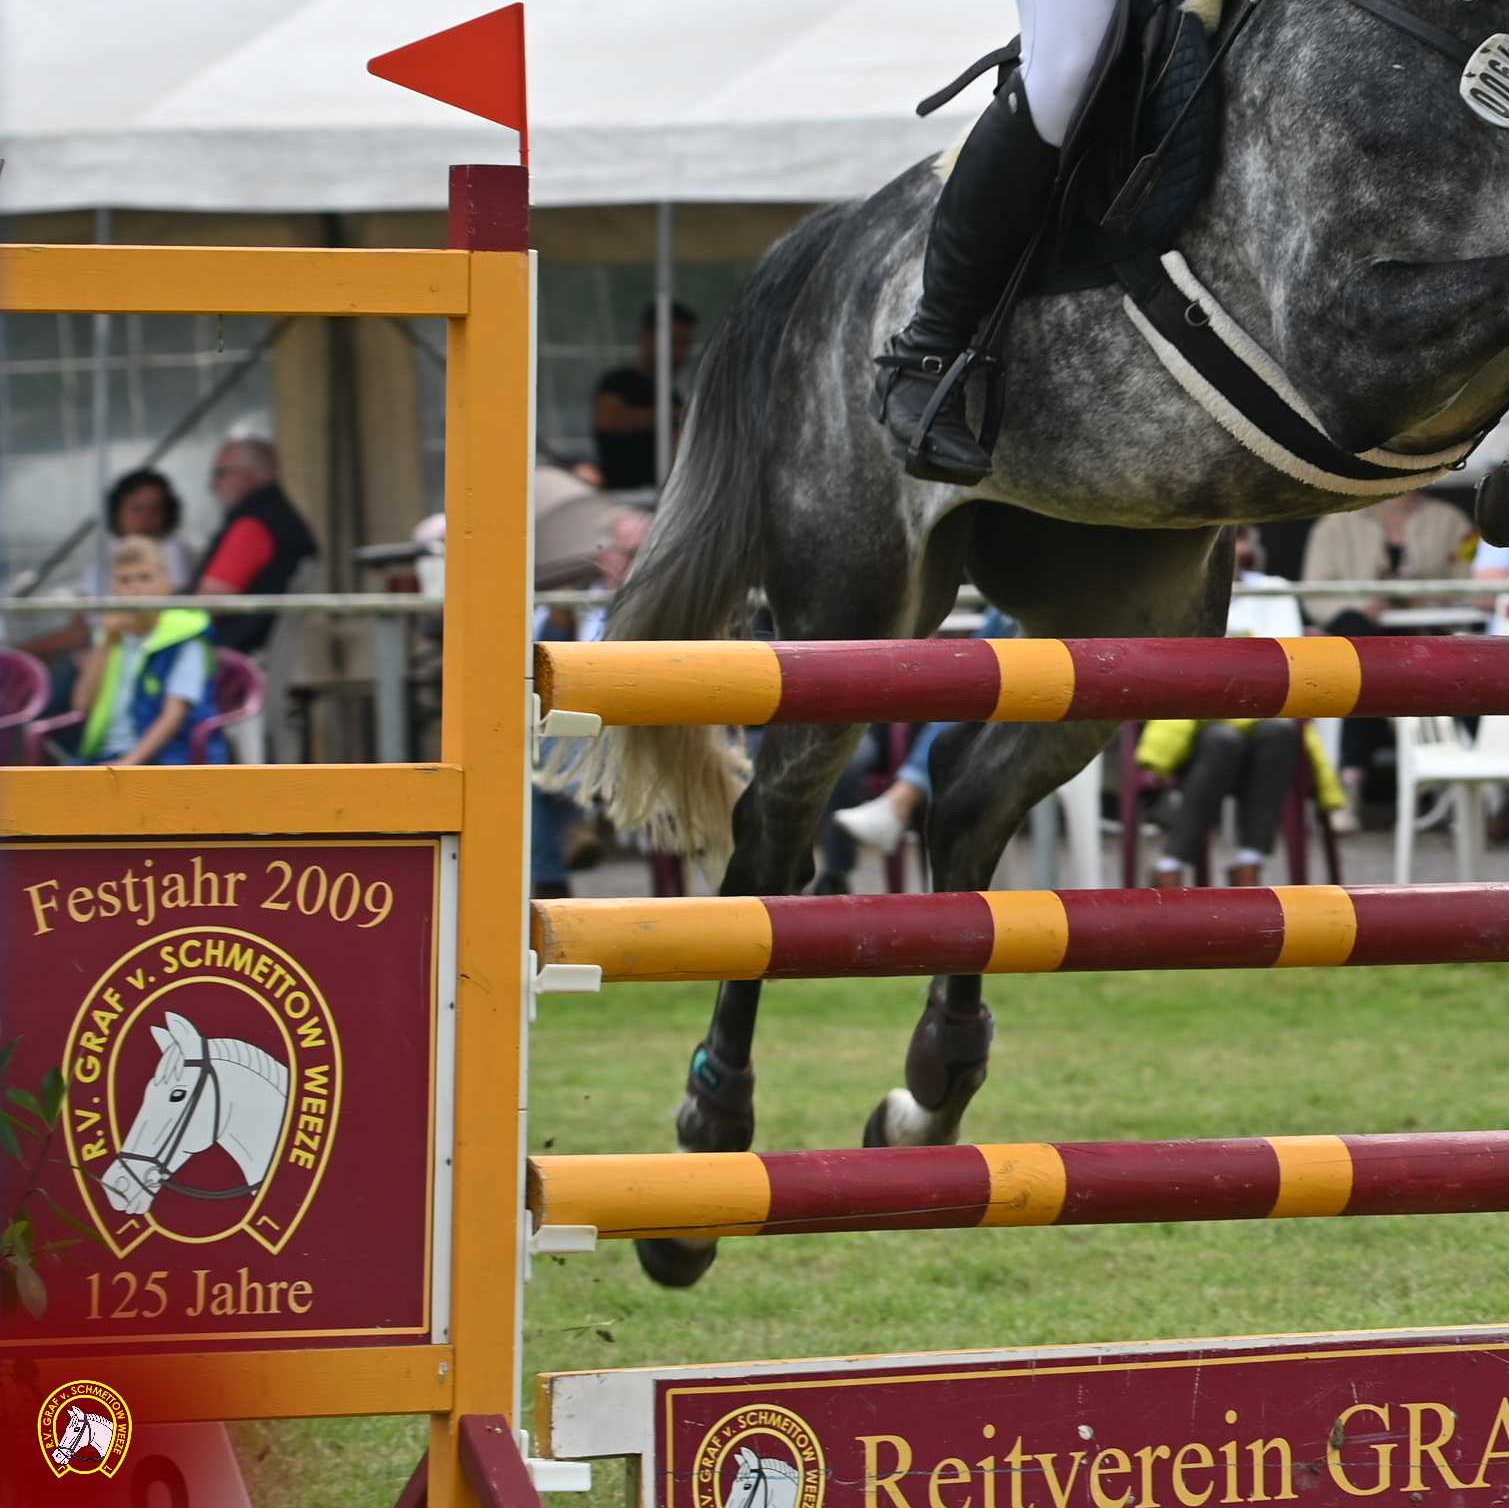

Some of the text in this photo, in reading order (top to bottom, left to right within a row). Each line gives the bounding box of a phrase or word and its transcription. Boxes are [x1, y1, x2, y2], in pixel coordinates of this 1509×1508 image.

[23, 855, 394, 936] Festjahr 2009
[74, 938, 330, 1170] R.V. GRAF v. SCHMETTOW WEEZE
[85, 1267, 313, 1321] 125 Jahre
[700, 1437, 722, 1483] GRAF
[722, 1428, 737, 1437] v.
[738, 1411, 817, 1462] SCHMETTOW
[801, 1468, 818, 1508] WEEZ
[855, 1409, 1298, 1508] Reitverein
